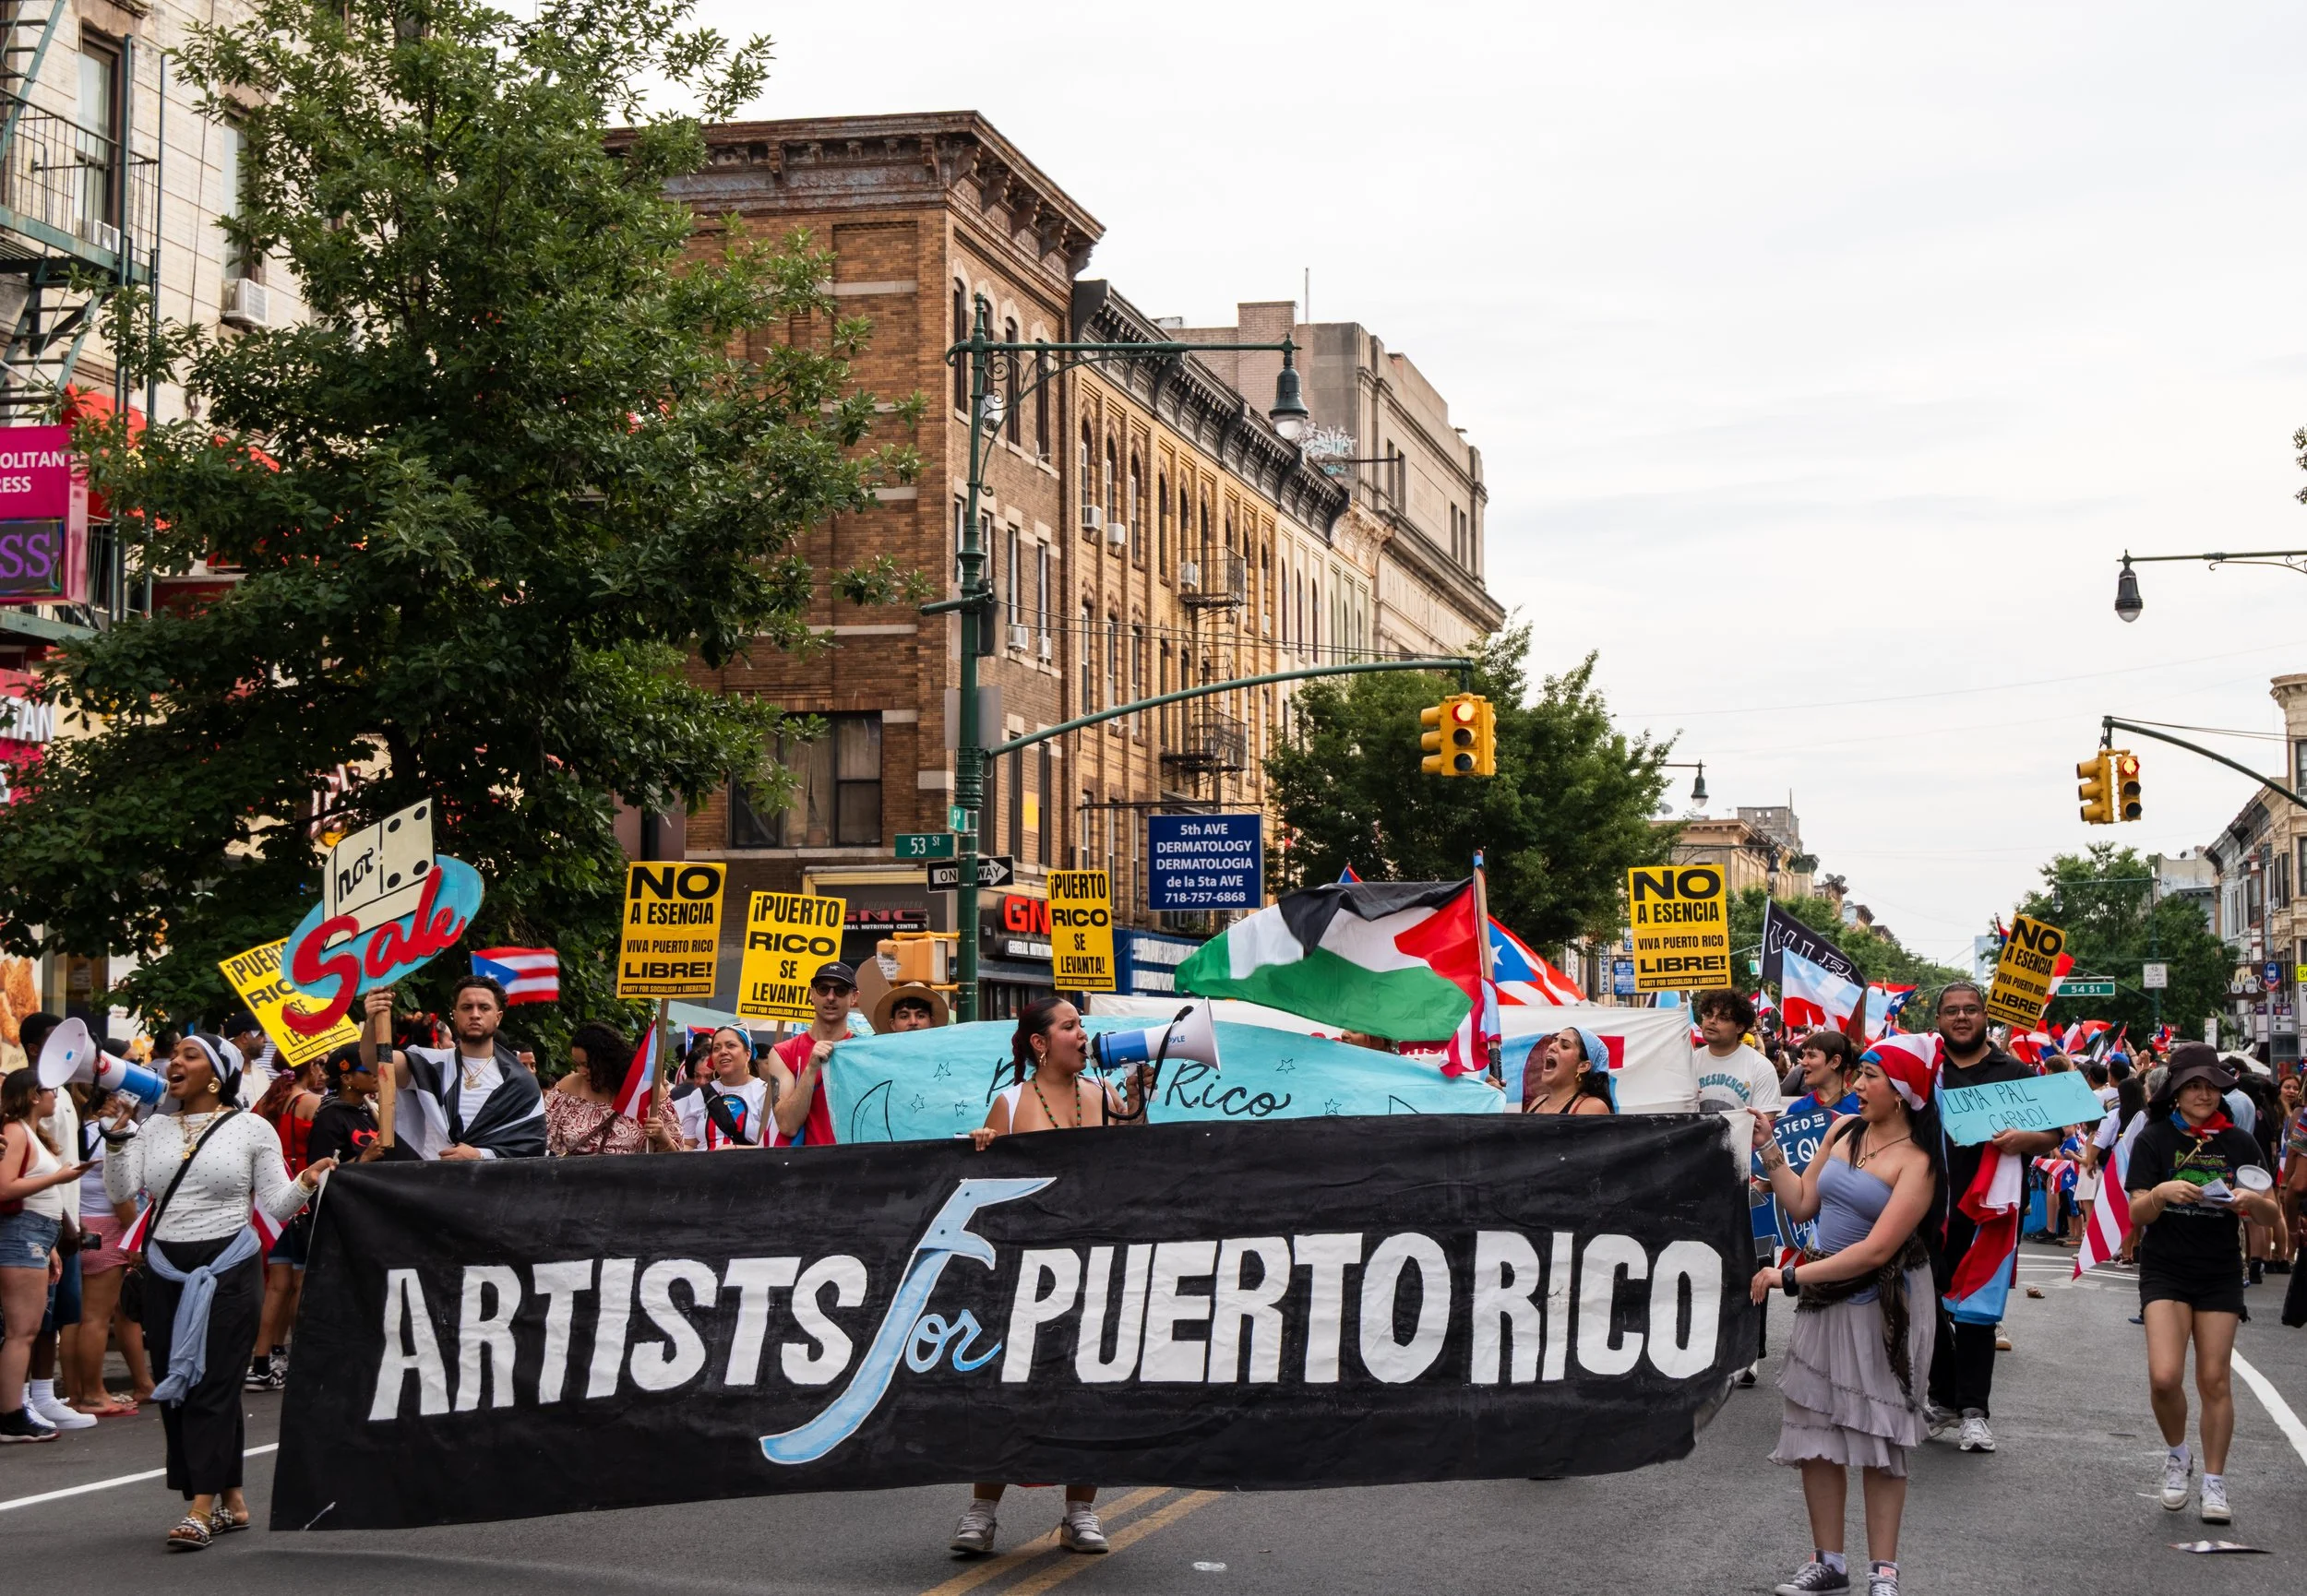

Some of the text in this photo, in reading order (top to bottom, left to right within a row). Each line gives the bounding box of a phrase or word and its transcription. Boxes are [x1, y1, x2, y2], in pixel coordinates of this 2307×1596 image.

[0, 476, 31, 493] ESS
[1180, 824, 1228, 835] 5th AVE
[911, 836, 939, 854] 53 St
[1156, 840, 1252, 853] DERMATOLOGY
[1156, 858, 1253, 870] DERMATOLOGIA
[629, 866, 721, 900] NO
[940, 870, 957, 881] ON
[1166, 875, 1243, 887] de la 5ta AVE
[1632, 869, 1721, 901] NO
[1165, 892, 1246, 903] 718-757-6868
[630, 902, 713, 924] A ESENCIA
[753, 895, 841, 928] ¡PUERTO
[1004, 894, 1051, 935] GN
[1051, 909, 1108, 927] RICO
[1637, 901, 1719, 923] A ESENCIA
[627, 939, 713, 953] VIVA PUERTO RICO
[748, 931, 836, 957] RICO
[1074, 933, 1086, 951] SE
[1638, 937, 1660, 950] VIVA
[1664, 935, 1699, 949] PUERTO
[1702, 935, 1724, 947] RICO
[2009, 918, 2062, 957] NO
[281, 865, 466, 1036] Sale
[625, 962, 713, 978] LIBRE!
[780, 959, 797, 979] SE
[1060, 956, 1105, 974] LEVANTA!
[1640, 955, 1727, 973] LIBRE!
[2004, 945, 2053, 976] A ESENCIA
[683, 984, 710, 993] LIBERATION
[1641, 979, 1656, 987] PARTY
[1656, 978, 1666, 986] FOR
[1997, 971, 2047, 997] VIVA PUERTO RICO
[2071, 985, 2100, 994] 54 St
[246, 979, 296, 1009] RIC
[1990, 989, 2042, 1016] LIBRE!
[1165, 1060, 1291, 1117] Rico
[1699, 1073, 1750, 1102] RESIDENCIA
[1942, 1088, 1991, 1114] LUMA
[368, 1255, 868, 1421] ARTISTS
[1000, 1232, 1451, 1384] PUERTO
[1471, 1230, 1724, 1385] RICO
